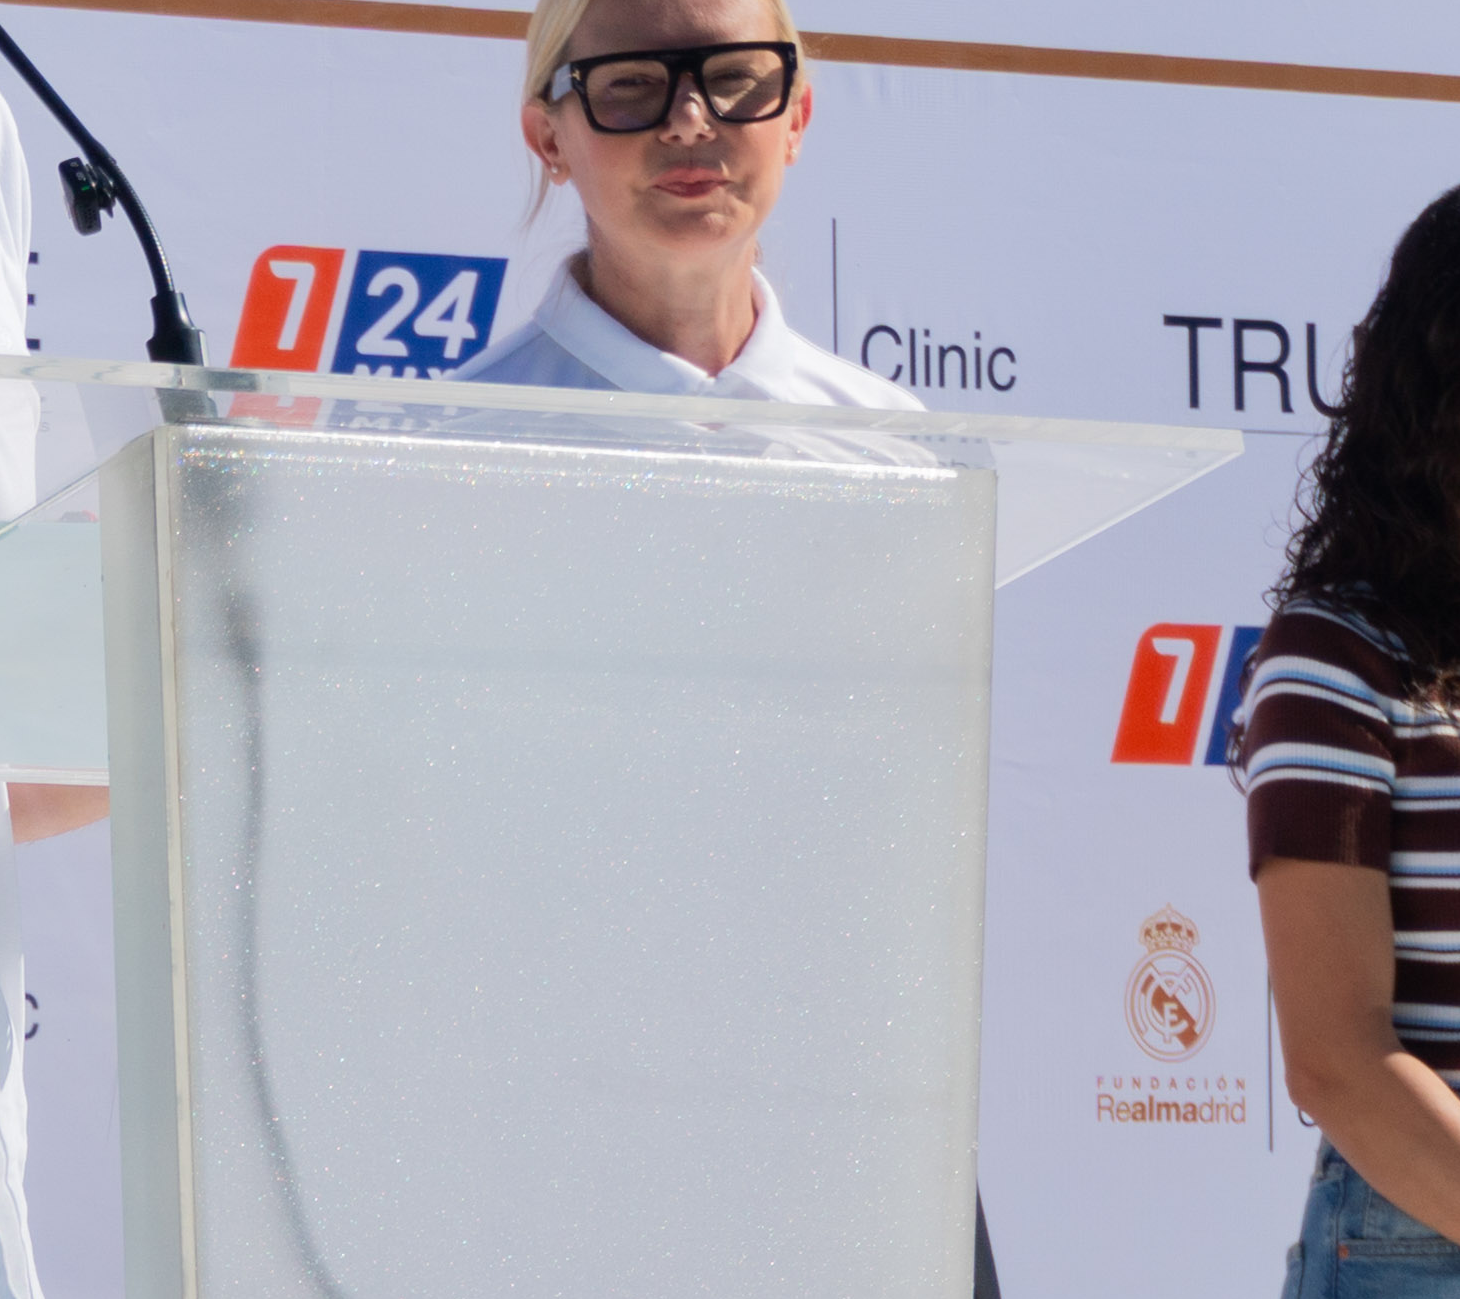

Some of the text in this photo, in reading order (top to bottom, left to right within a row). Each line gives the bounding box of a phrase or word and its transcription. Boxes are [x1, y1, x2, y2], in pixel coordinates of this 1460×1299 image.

[355, 267, 478, 358] 24
[861, 324, 1016, 392] Clinic
[1097, 1075, 1245, 1091] FUNDACIÓN
[1097, 1094, 1245, 1123] Realmadrid
